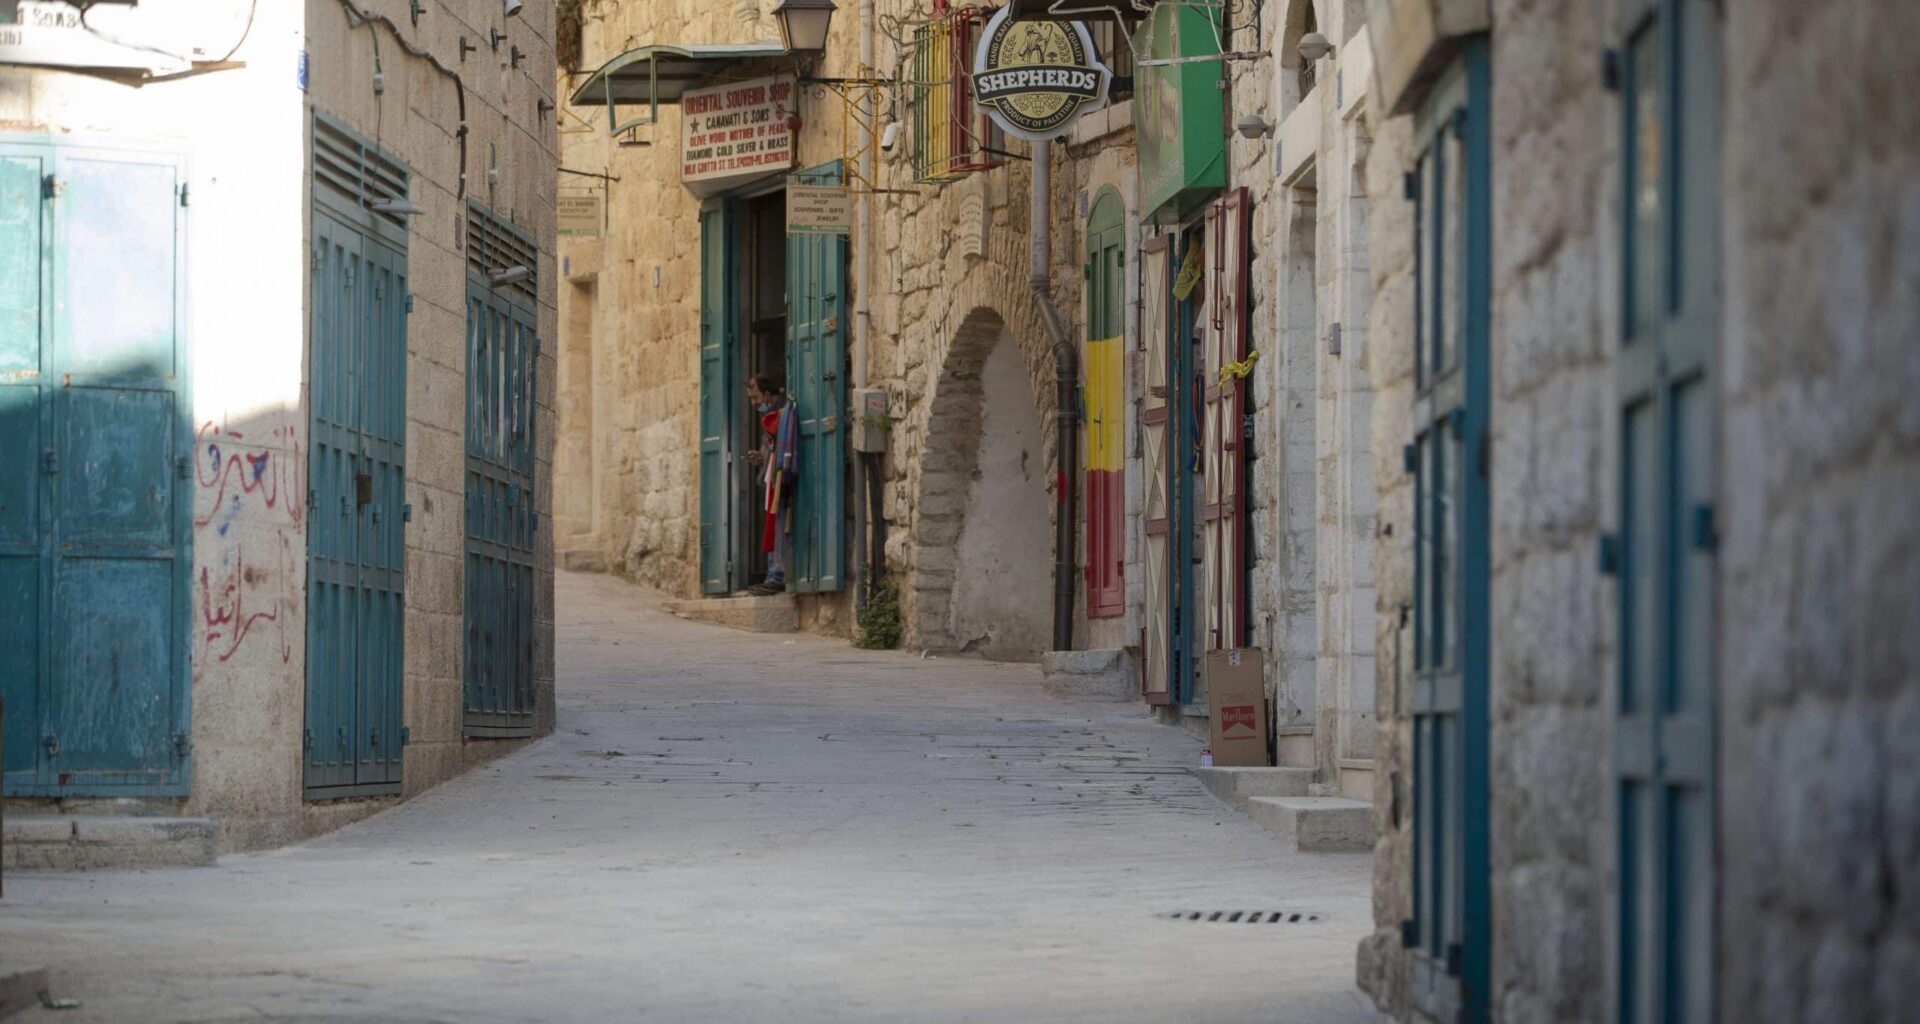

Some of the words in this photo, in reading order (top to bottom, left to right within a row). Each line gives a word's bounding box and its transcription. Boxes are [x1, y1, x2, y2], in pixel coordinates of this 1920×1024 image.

[990, 42, 1000, 65] HAND
[1068, 31, 1083, 63] QUALITY
[978, 69, 1096, 94] SHEPHERDS
[685, 92, 723, 116] ORIENTAL
[726, 86, 766, 109] SOUVENIR
[769, 81, 791, 102] SHOP
[706, 112, 741, 130] CANAVATI
[743, 111, 748, 125] &
[751, 108, 770, 123] SONS
[1001, 100, 1030, 127] PRODUCT
[1032, 118, 1042, 128] OF
[1044, 101, 1075, 127] PALESTINE
[686, 147, 713, 161] DIAMOND
[716, 145, 733, 157] GOLD
[736, 141, 756, 154] SILVER
[760, 140, 764, 151] &
[768, 136, 788, 150] BRASS
[690, 134, 706, 148] OLIVE
[709, 131, 726, 144] WOOD
[729, 127, 754, 141] MOTHER
[757, 126, 765, 137] OF
